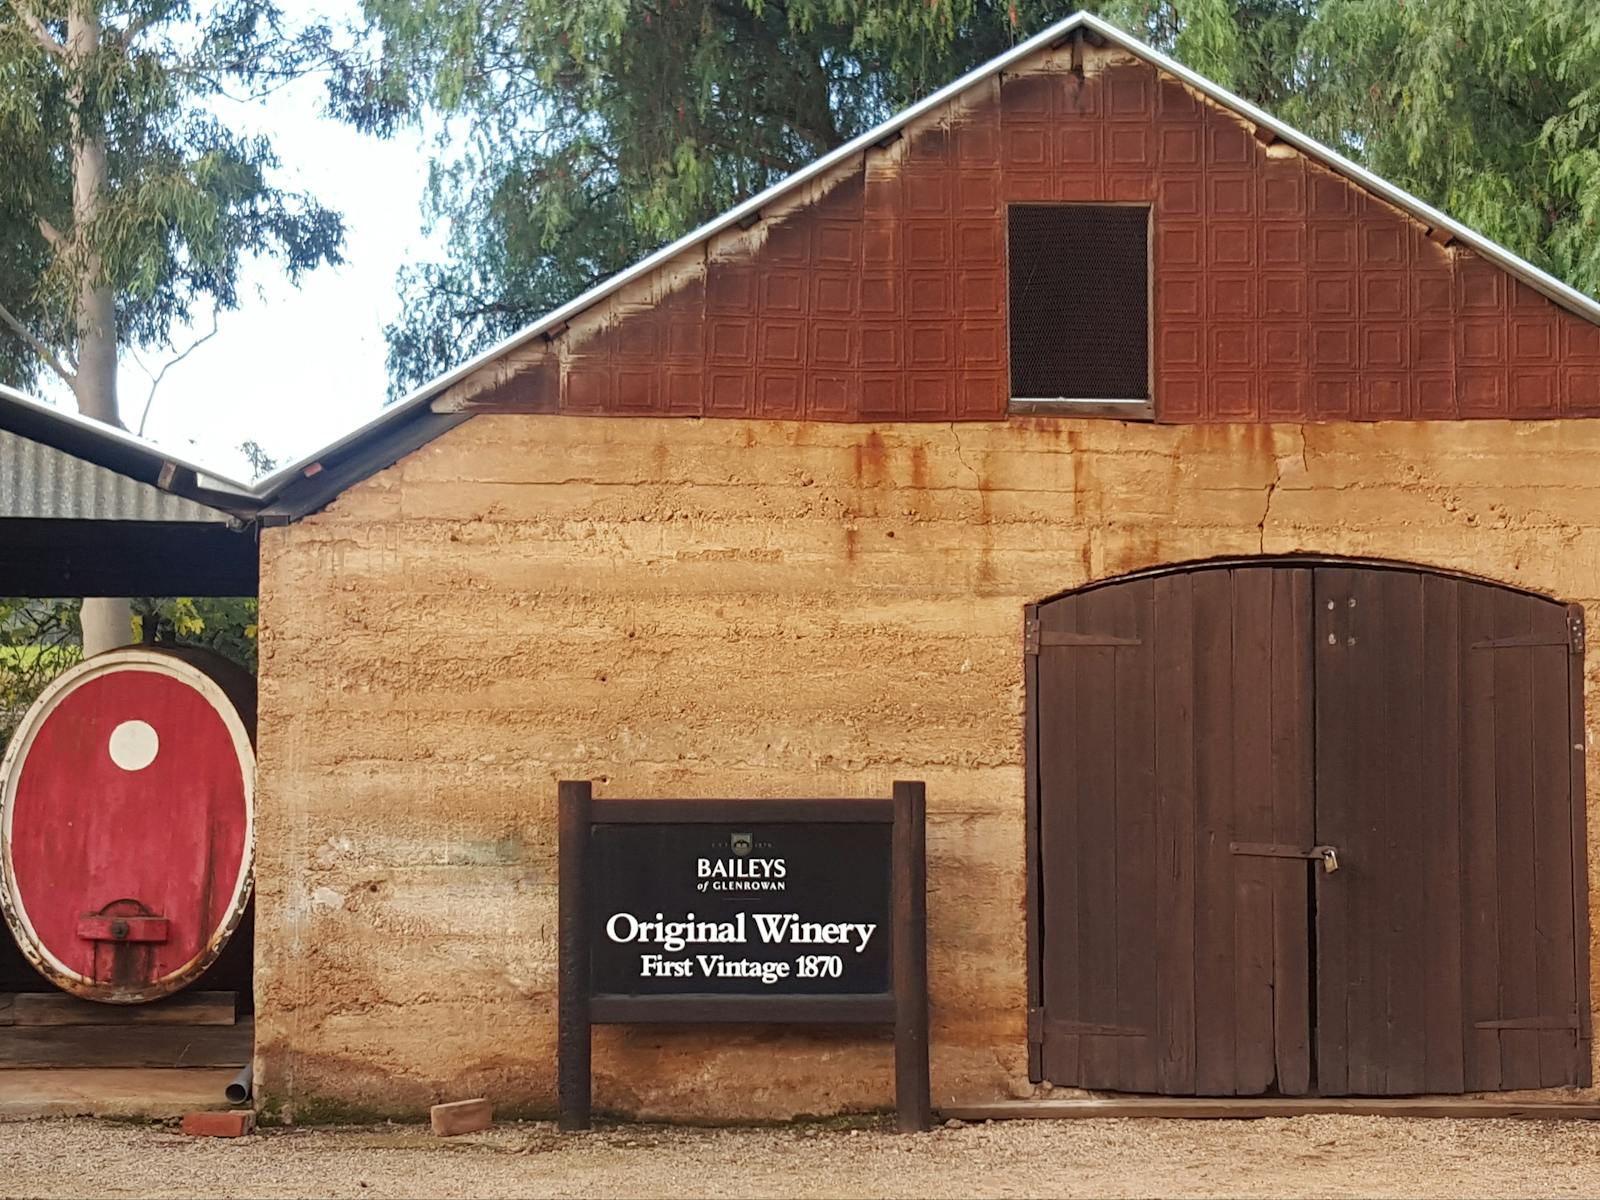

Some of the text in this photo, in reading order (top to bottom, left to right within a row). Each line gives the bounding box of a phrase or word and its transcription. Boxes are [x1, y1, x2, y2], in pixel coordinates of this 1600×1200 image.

[697, 858, 787, 878] BAILEYS
[696, 881, 786, 893] of GLENROWAN
[606, 912, 877, 952] Original Winery
[640, 954, 843, 983] First Vintage 1870
